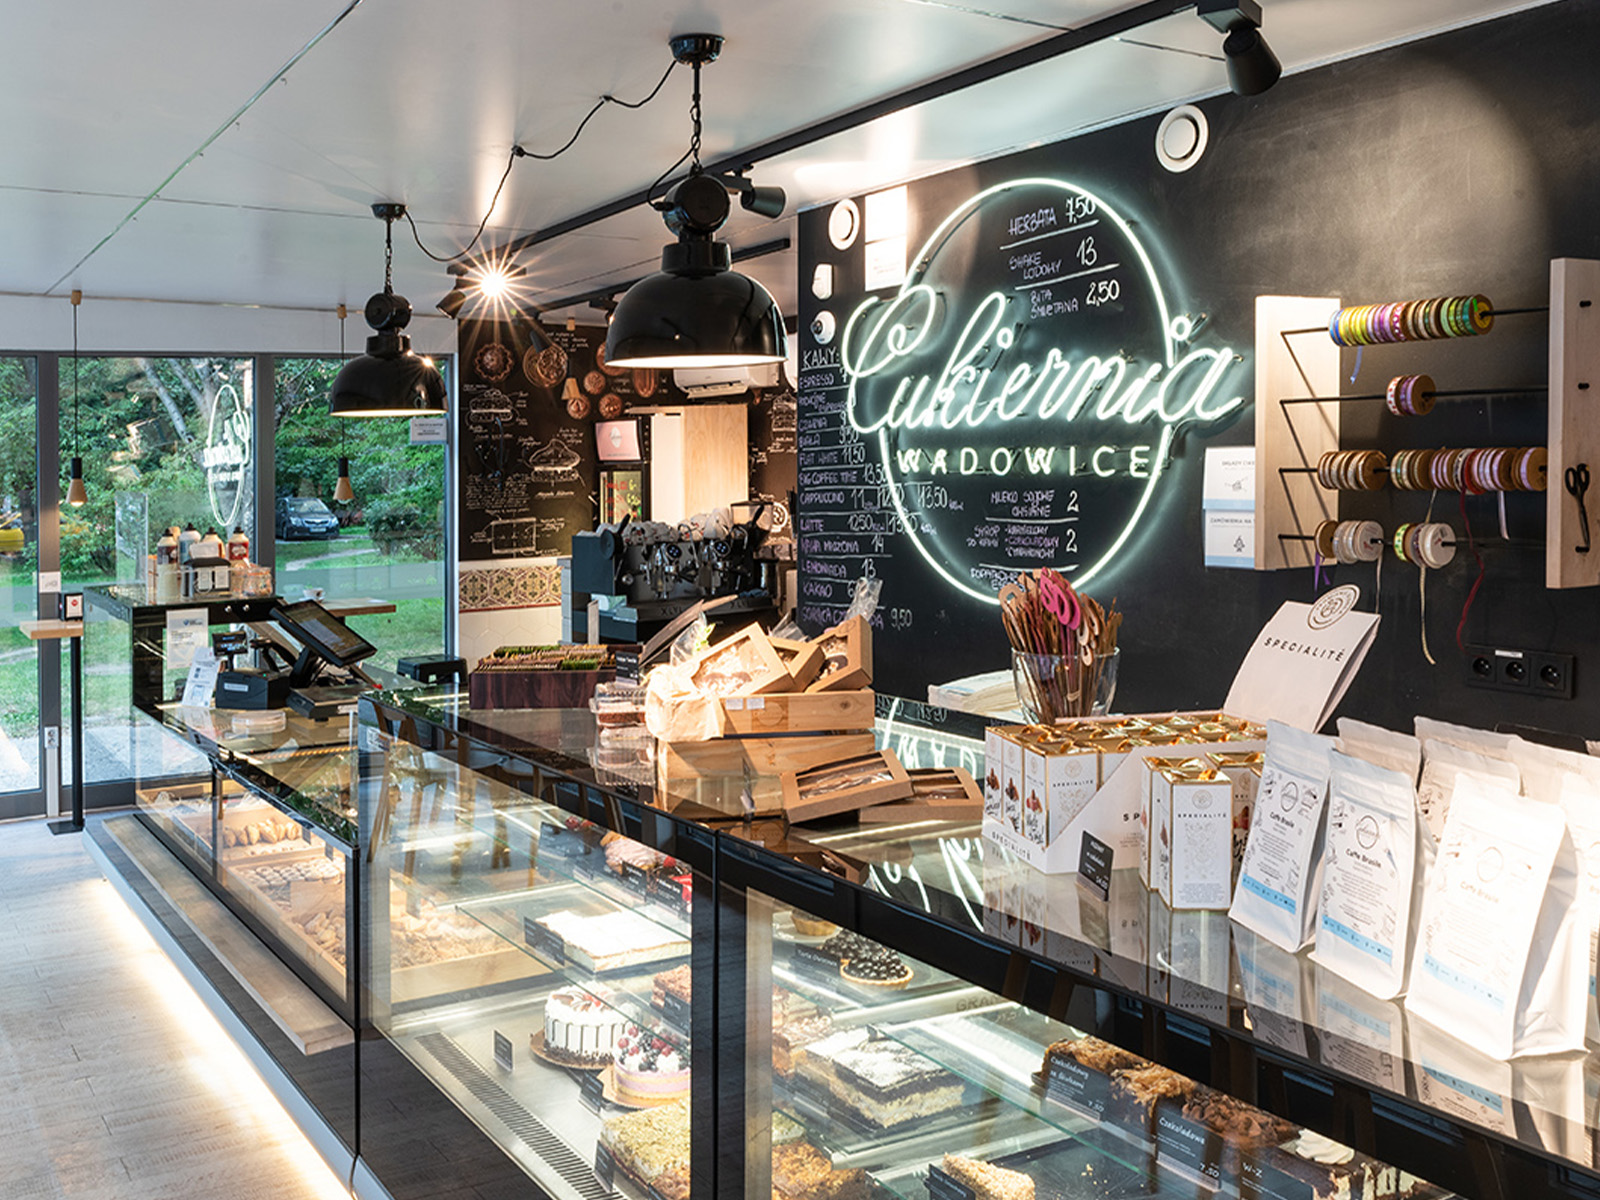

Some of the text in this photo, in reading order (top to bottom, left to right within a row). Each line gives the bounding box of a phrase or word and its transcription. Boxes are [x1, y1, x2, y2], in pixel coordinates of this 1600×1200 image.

[1008, 207, 1057, 235] HERBATA
[1009, 236, 1098, 270] SHAKE 13
[1023, 259, 1062, 280] LODOWY
[1086, 279, 1120, 307] 2,50
[843, 285, 1243, 434] Cukiernia
[799, 372, 835, 389] ESPRESSO
[897, 446, 1151, 477] WADOWICE
[800, 491, 845, 505] CAPPUCCINO
[1067, 490, 1080, 512] 2
[800, 519, 824, 532] LATTE
[1066, 529, 1078, 553] 2
[803, 583, 833, 598] KAKAO
[1264, 637, 1346, 662] SPECIALITÉ
